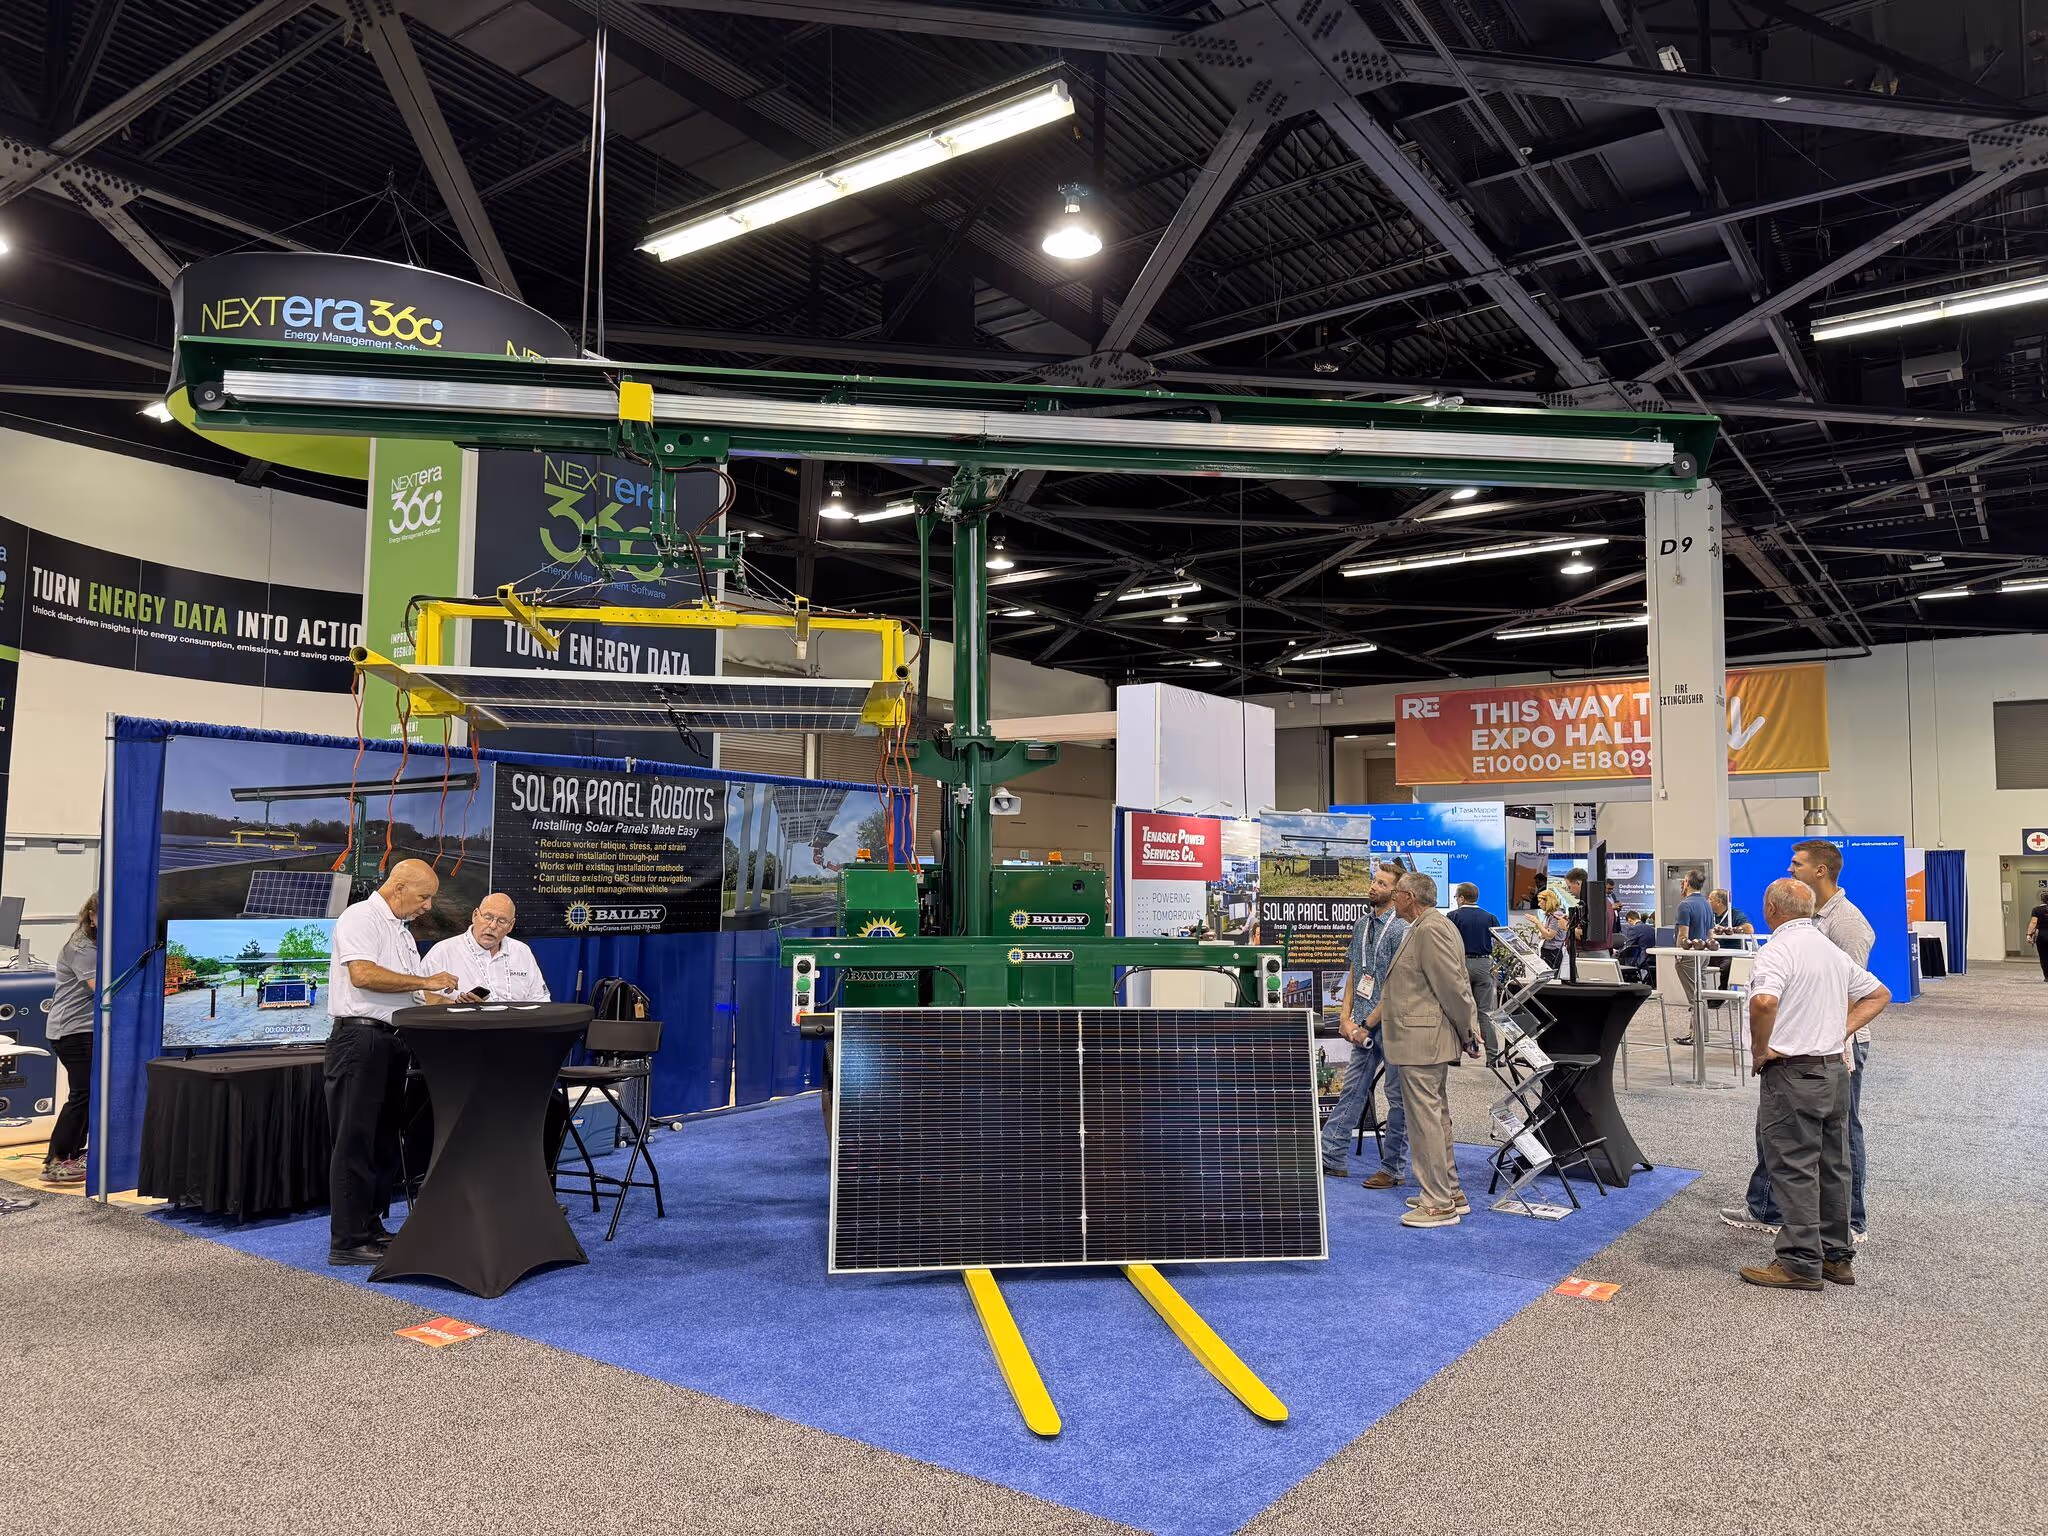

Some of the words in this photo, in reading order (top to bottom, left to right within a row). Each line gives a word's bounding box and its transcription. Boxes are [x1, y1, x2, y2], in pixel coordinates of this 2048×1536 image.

[284, 329, 319, 342] Energy
[322, 332, 392, 350] Management
[390, 465, 442, 493] NEXTera
[541, 562, 572, 579] Energy
[630, 583, 666, 600] Software
[33, 566, 80, 608] TURN
[88, 581, 166, 624] ENERGY
[173, 599, 228, 635] DATA
[237, 610, 288, 643] INTO
[296, 618, 362, 648] ACTIO
[32, 604, 56, 618] Unlock
[57, 611, 99, 628] data-driven
[100, 620, 131, 634] insights
[132, 627, 149, 637] into
[150, 631, 178, 643] energy
[179, 635, 235, 651] consumption,
[236, 644, 281, 656] emissions,
[283, 649, 299, 657] and
[300, 650, 327, 662] saving
[569, 632, 641, 674] ENERGY
[648, 647, 691, 677] DATA
[1674, 684, 1688, 694] FIRE
[1660, 693, 1704, 706] EXTINGUISHER
[1471, 700, 1540, 725] THIS
[1549, 694, 1624, 721] WAY
[1633, 692, 1650, 716] T
[1472, 724, 1556, 751] EXPO
[511, 773, 579, 814] SOLAR
[585, 779, 644, 818] PANEL
[650, 784, 714, 821] ROBOTS
[532, 819, 582, 834] Installing
[585, 821, 614, 833] Solar
[615, 822, 649, 835] Panels
[651, 824, 675, 835] Made
[677, 825, 699, 838] Easy
[540, 839, 571, 848] Reduce
[573, 840, 598, 849] worker
[629, 842, 653, 851] stress,
[654, 843, 667, 851] and
[1407, 839, 1434, 848] digital
[1436, 839, 1456, 847] twin
[540, 850, 574, 859] Increase
[576, 851, 617, 860] installation
[618, 852, 659, 862] through-put
[539, 861, 565, 870] Works
[567, 862, 584, 870] with
[585, 863, 615, 873] existing
[616, 863, 655, 872] installation
[656, 864, 684, 872] methods
[539, 873, 555, 882] Can
[557, 873, 580, 881] utilize
[582, 874, 613, 884] existing
[614, 874, 630, 882] GPS
[631, 874, 646, 883] data
[647, 874, 657, 882] for
[658, 874, 692, 884] navigation
[538, 885, 572, 893] Includes
[573, 885, 595, 895] pallet
[596, 885, 643, 895] management
[644, 885, 669, 893] vehicle
[1152, 892, 1191, 903] POWERING
[595, 909, 661, 920] BAILEY
[1152, 909, 1201, 921] TOMORROW'S
[1263, 902, 1295, 921] SOLAR
[1297, 903, 1329, 921] PANEL
[1332, 903, 1369, 921] ROBOTS
[1032, 916, 1086, 924] BAILEY
[845, 970, 919, 981] BAILEY
